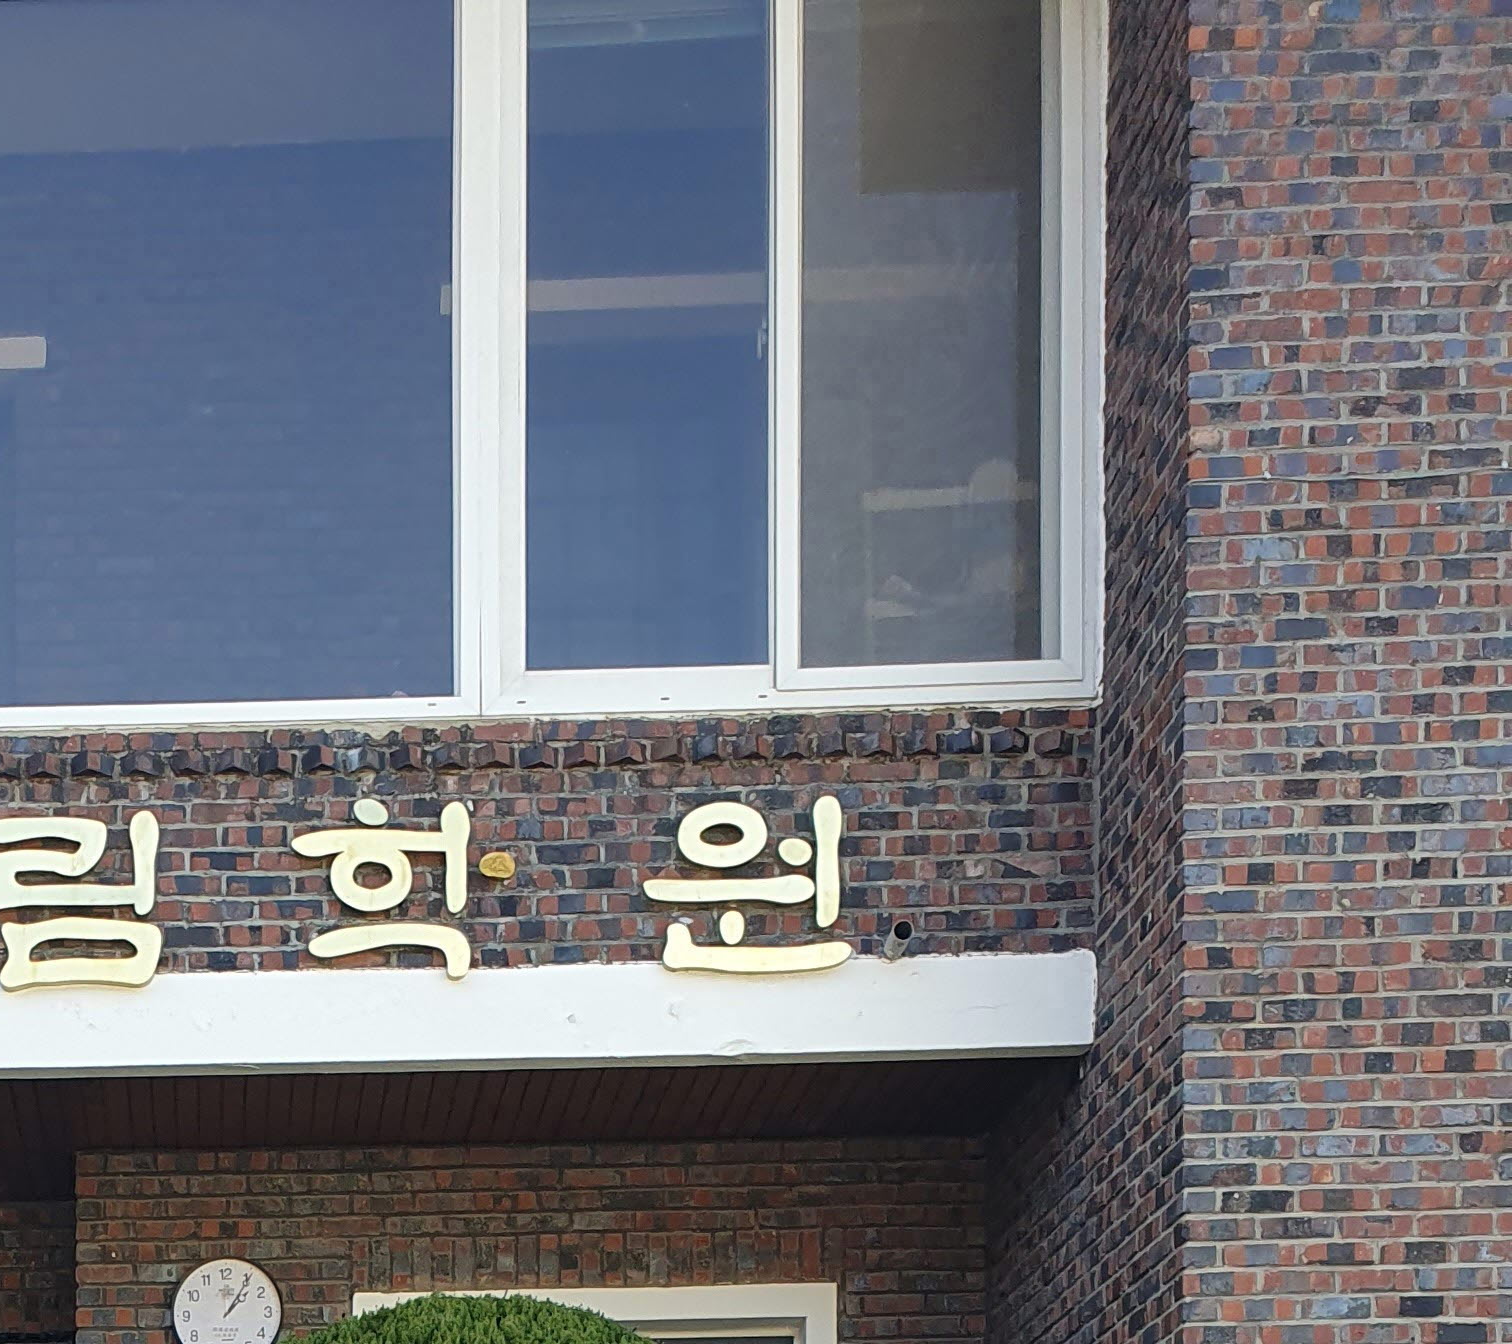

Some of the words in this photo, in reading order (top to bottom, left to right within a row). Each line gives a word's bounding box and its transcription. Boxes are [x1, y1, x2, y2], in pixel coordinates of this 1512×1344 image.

[219, 1268, 232, 1280] 12
[201, 1275, 211, 1286] 11
[188, 1290, 200, 1302] 10
[257, 1286, 265, 1298] 2
[182, 1311, 191, 1322] 9
[264, 1306, 272, 1318] 3
[190, 1330, 198, 1342] 8
[257, 1327, 265, 1339] 4
